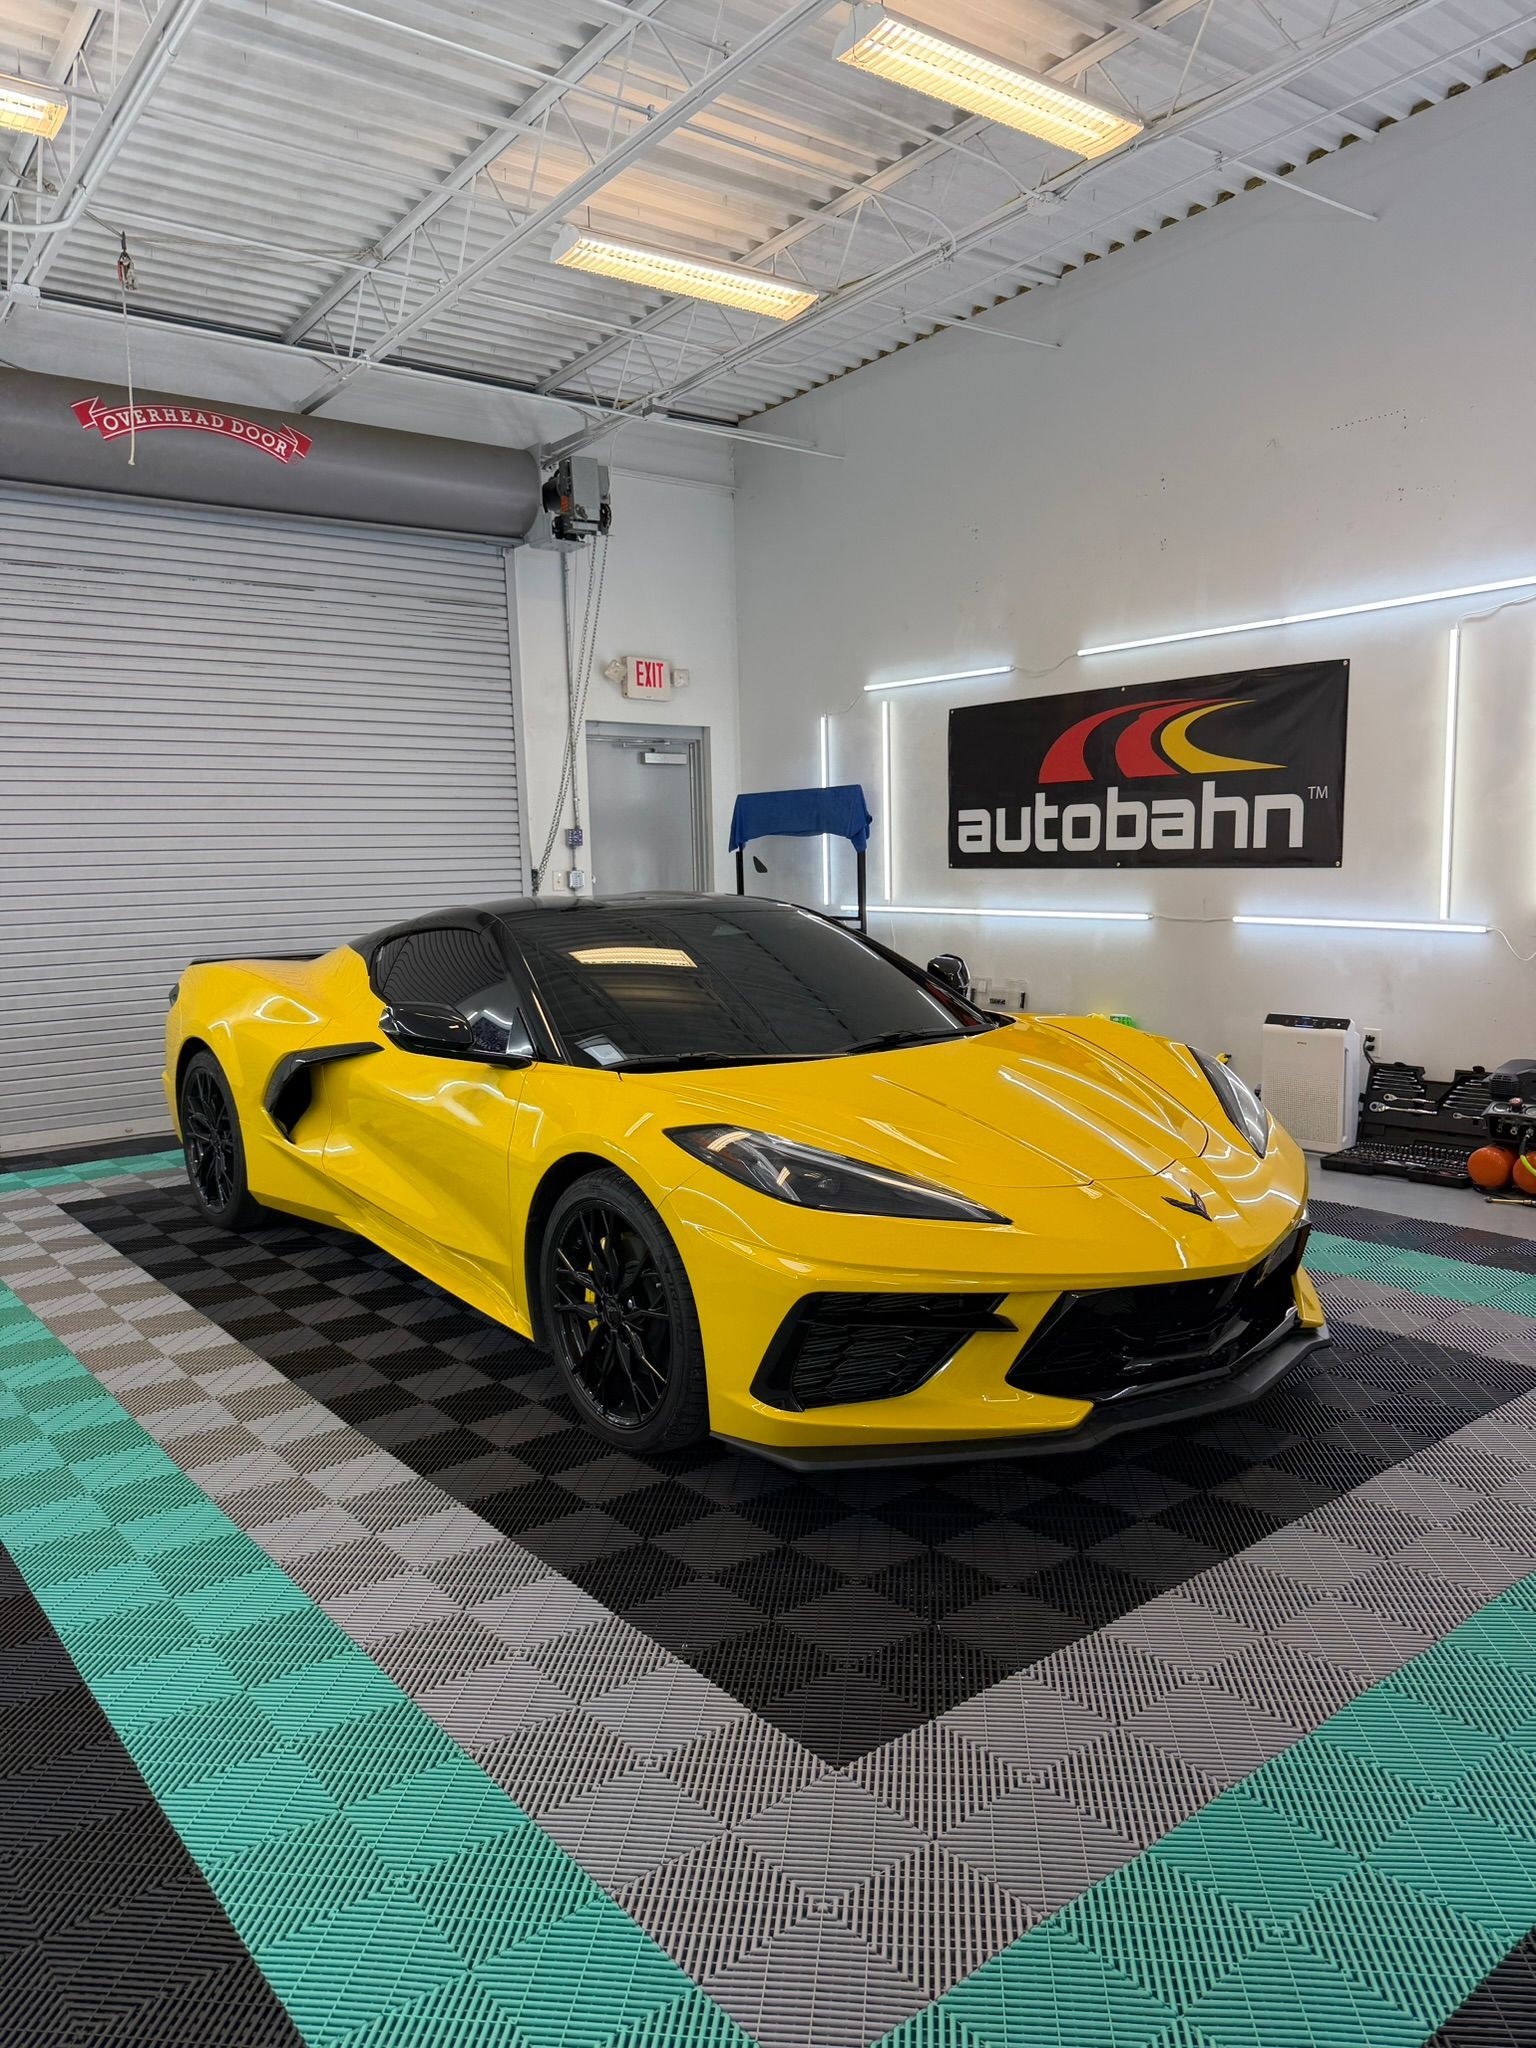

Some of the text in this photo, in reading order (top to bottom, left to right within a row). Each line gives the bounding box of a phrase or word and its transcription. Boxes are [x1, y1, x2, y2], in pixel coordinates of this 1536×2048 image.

[103, 408, 288, 457] OVERHEAD DOOR
[636, 660, 664, 689] EXIT
[957, 780, 1305, 854] autobahn
